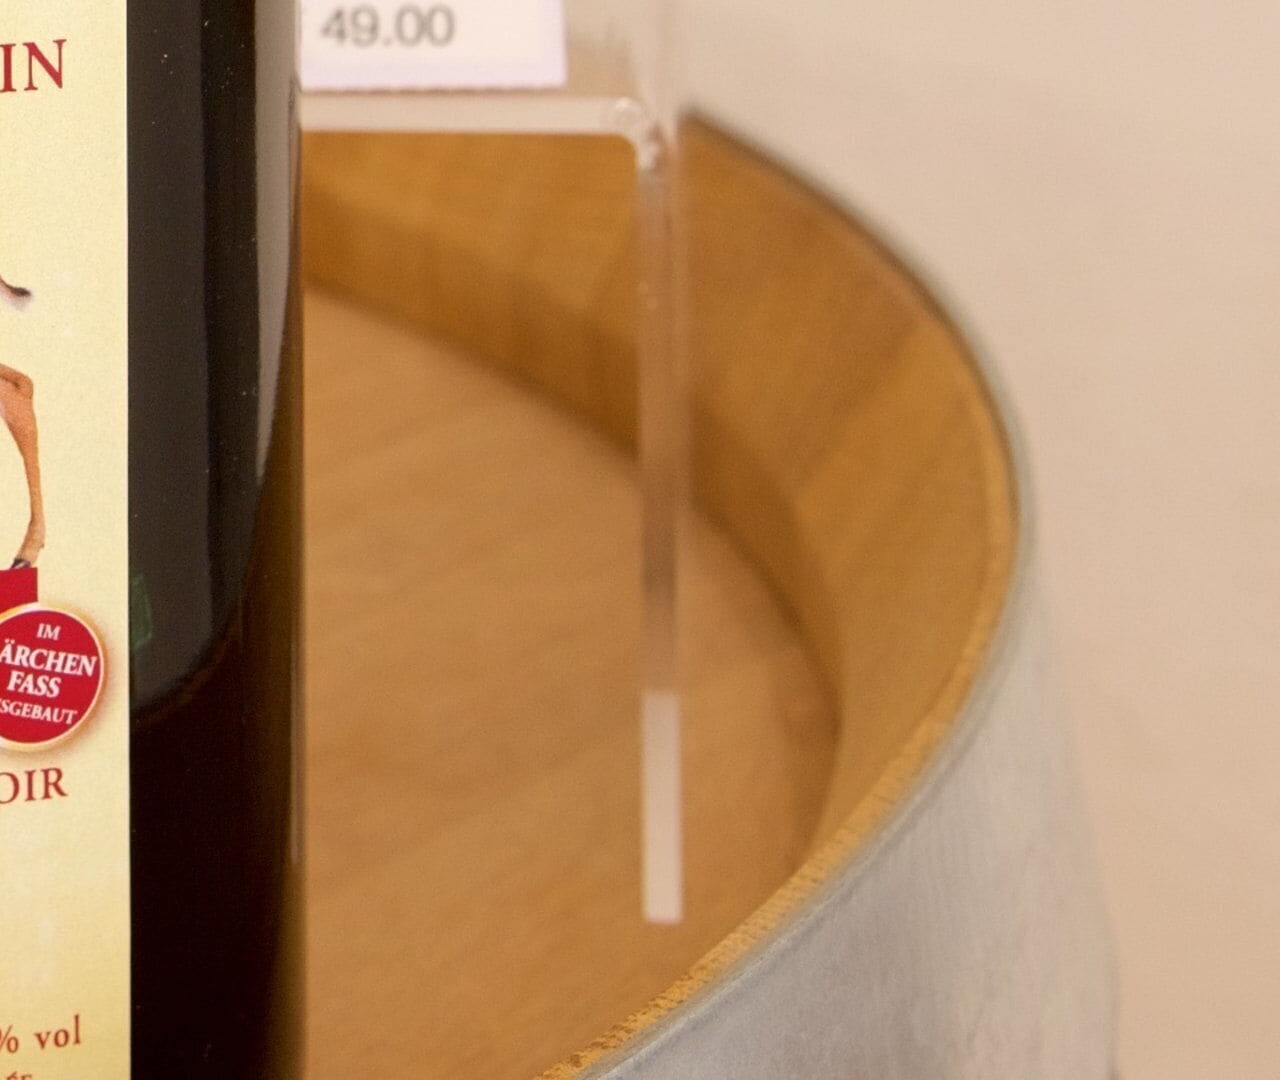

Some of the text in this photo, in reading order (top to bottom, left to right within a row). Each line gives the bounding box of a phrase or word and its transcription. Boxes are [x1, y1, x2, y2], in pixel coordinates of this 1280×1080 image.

[320, 3, 455, 48] 49.00
[36, 623, 61, 641] IM
[7, 671, 62, 698] FASS
[34, 1014, 81, 1050] vol
